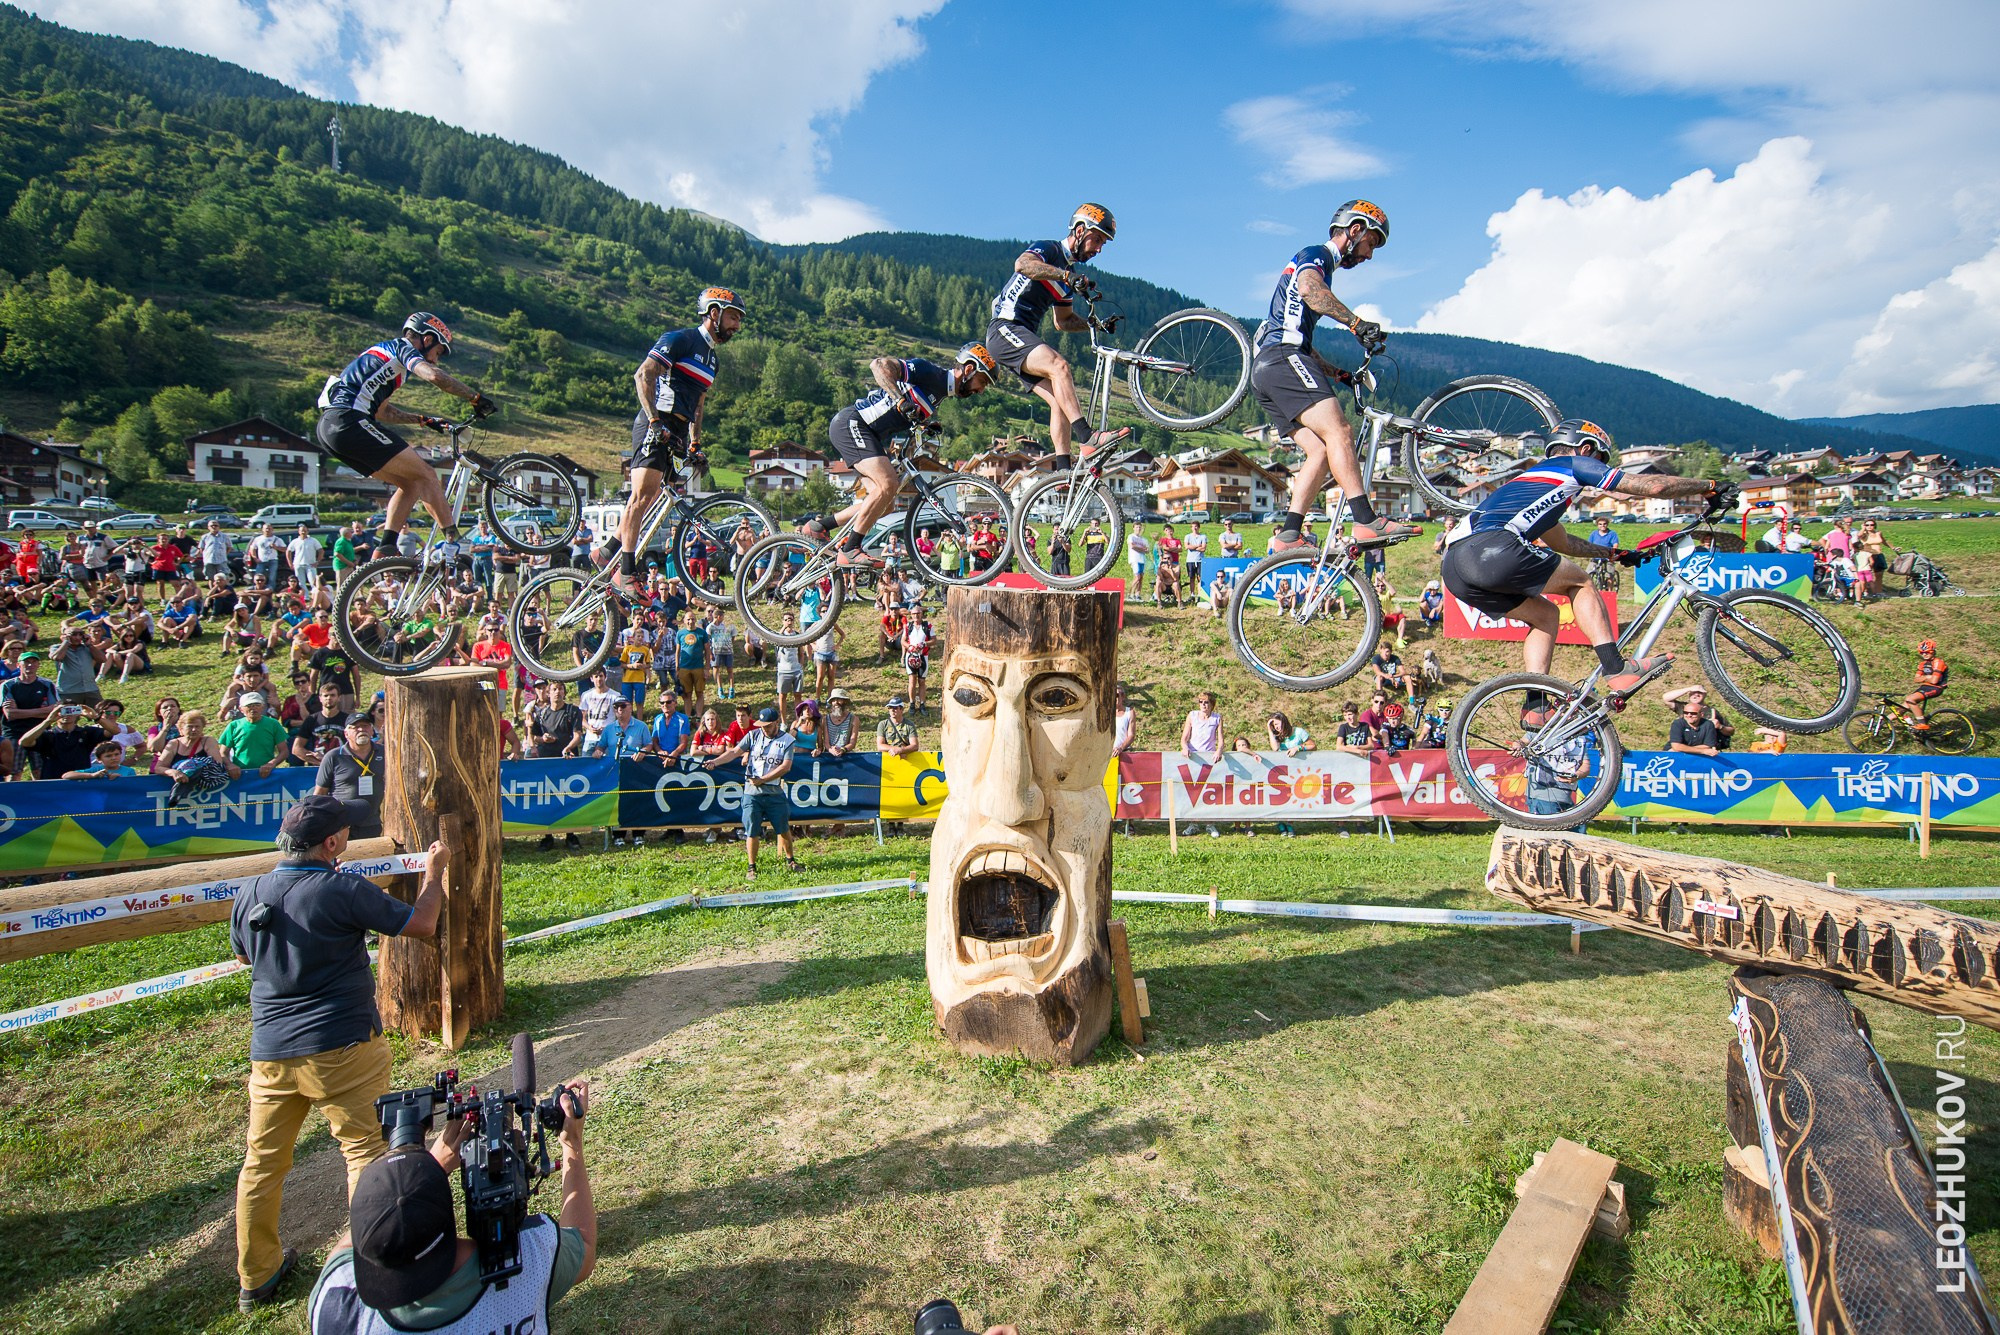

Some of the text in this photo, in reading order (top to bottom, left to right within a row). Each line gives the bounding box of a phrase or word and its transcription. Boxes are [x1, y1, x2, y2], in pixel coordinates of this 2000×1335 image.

[1008, 275, 1029, 302] FRANC
[365, 366, 396, 393] FRANCE
[1522, 490, 1567, 524] FRANCE
[501, 774, 590, 809] NTINO
[1177, 764, 1356, 808] Val di Sole
[1388, 763, 1445, 806] Val
[1622, 762, 1752, 799] TRENTINO
[1832, 766, 1979, 803] TRENTNO
[147, 785, 317, 829] TRENTIN
[402, 858, 417, 870] Val
[123, 893, 195, 913] Val di Sole
[202, 886, 241, 901] TRENT
[31, 905, 107, 929] TRENTINO
